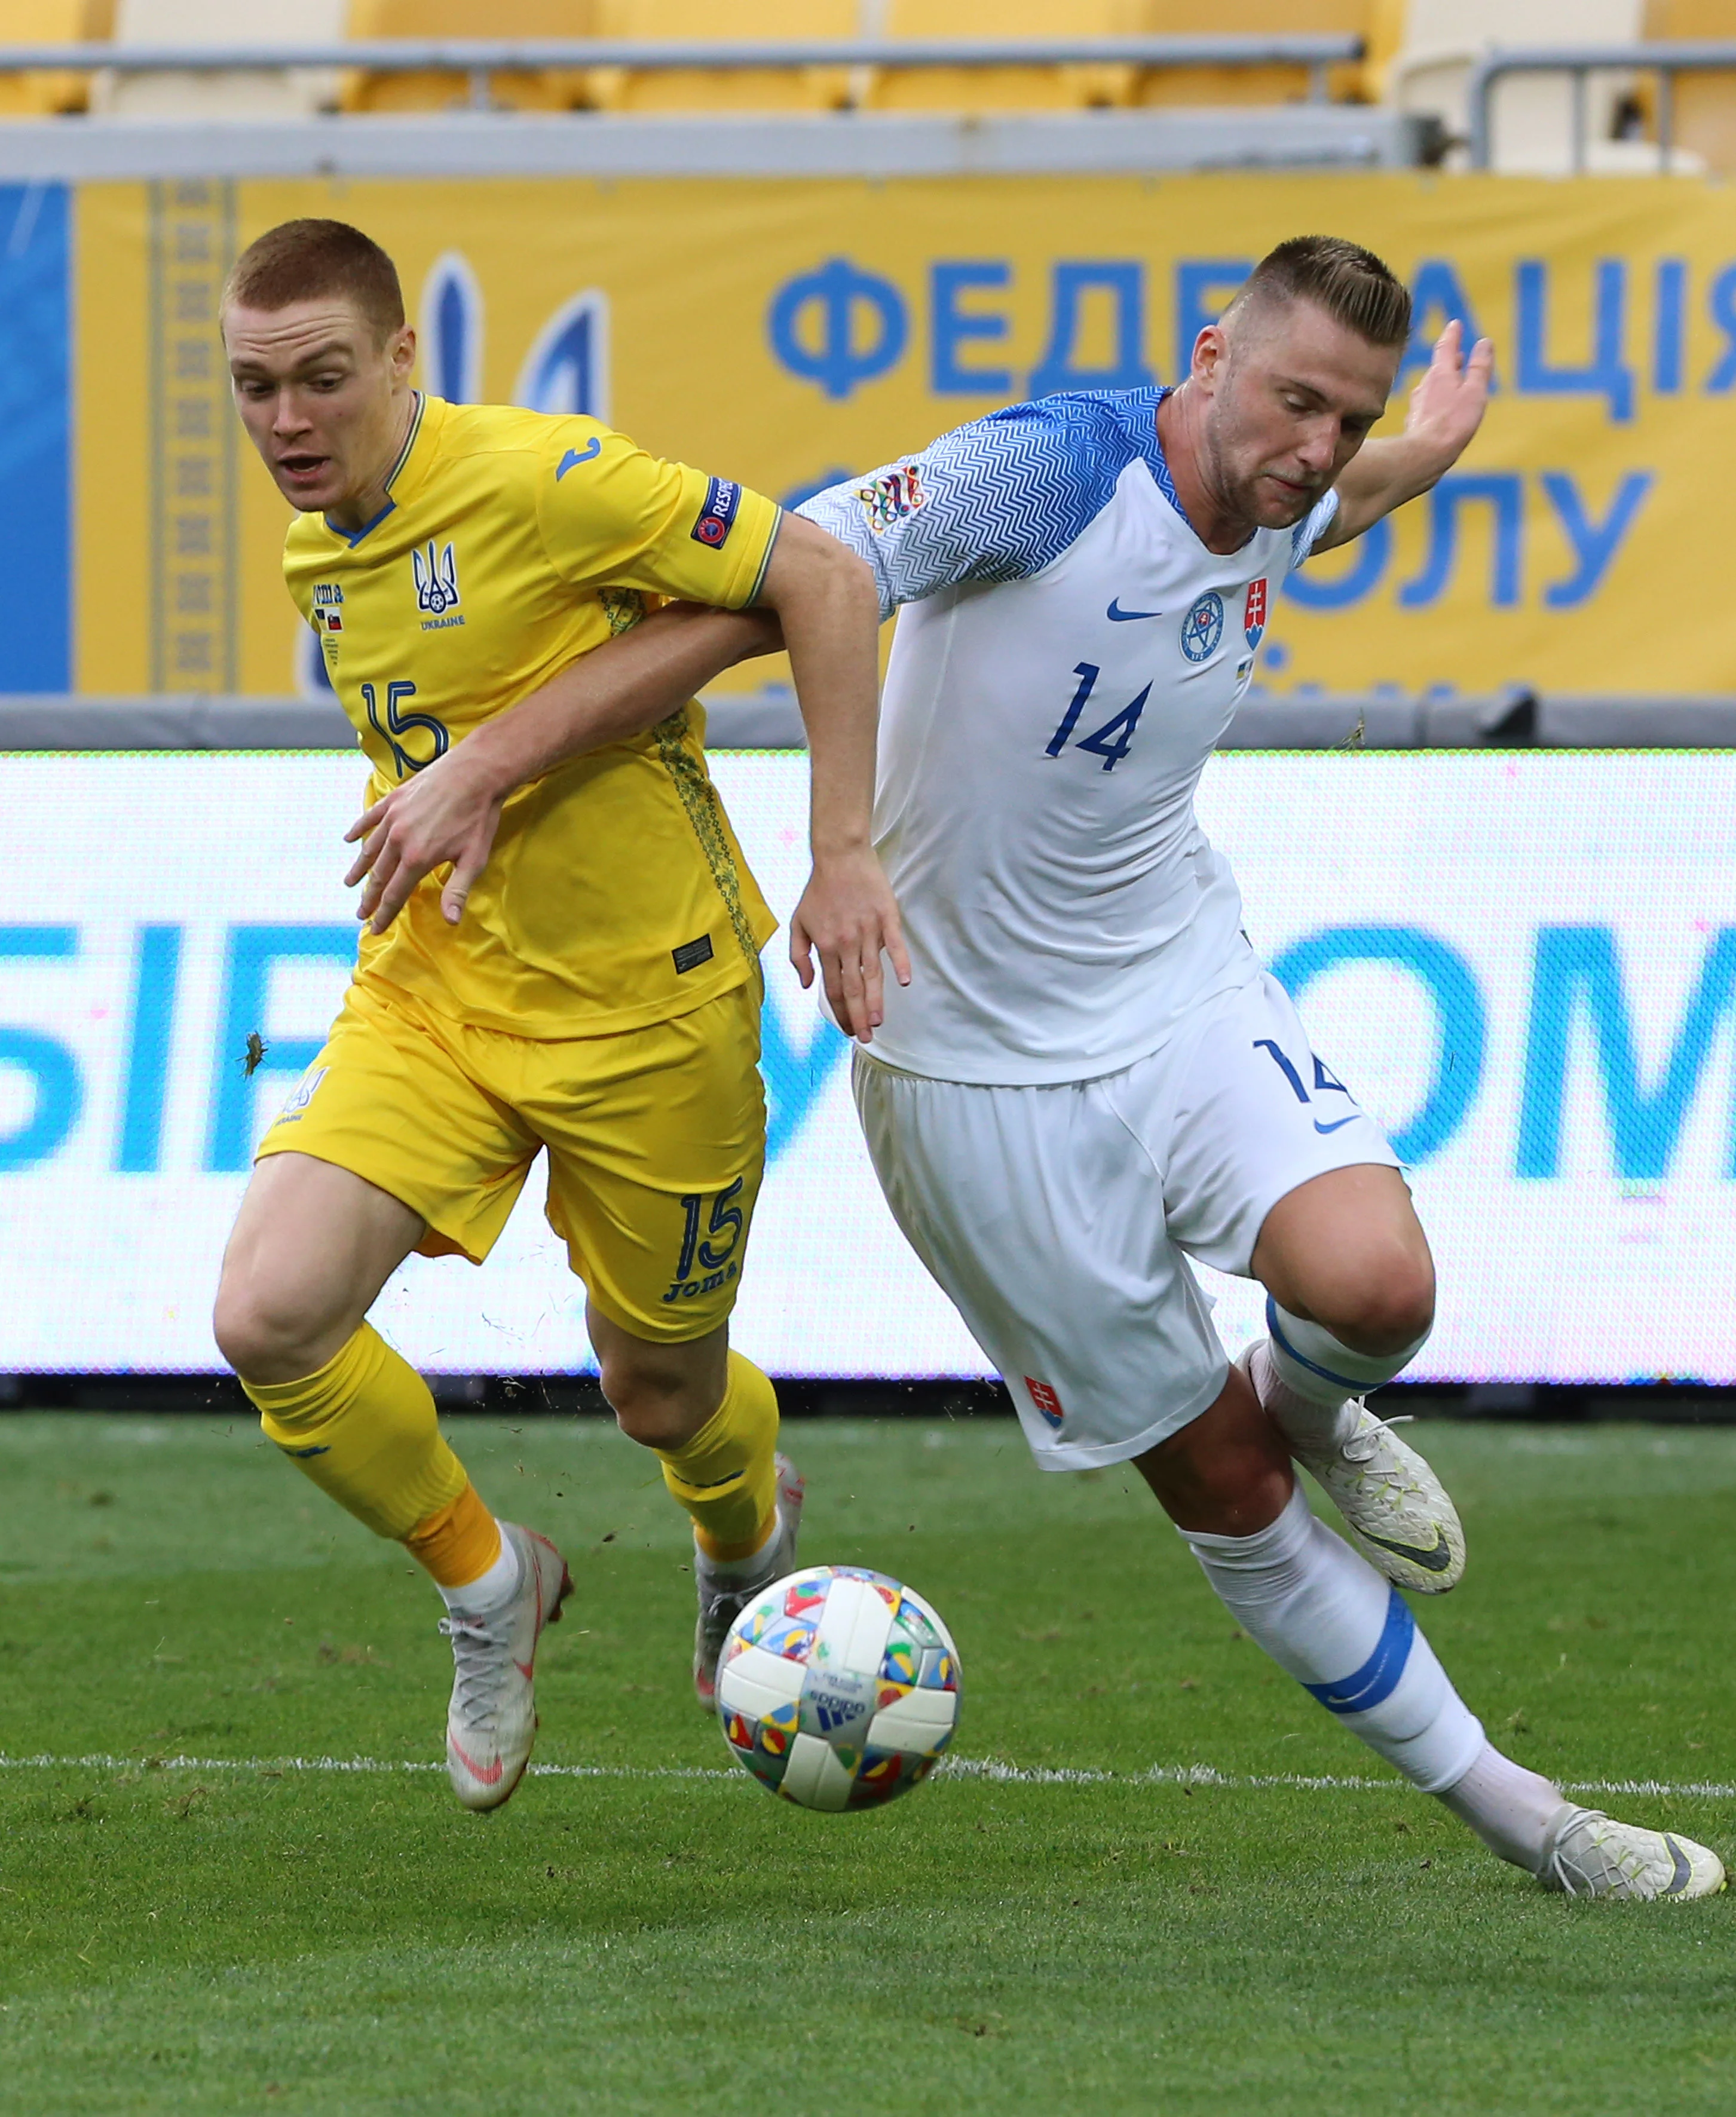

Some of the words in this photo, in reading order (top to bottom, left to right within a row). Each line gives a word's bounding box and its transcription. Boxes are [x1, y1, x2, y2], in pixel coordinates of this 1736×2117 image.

[767, 254, 1736, 425] ФЕДЕАЦІ
[420, 615, 465, 630] UKRAINE
[361, 680, 449, 779] 15
[1045, 661, 1154, 772] 14
[1252, 1038, 1359, 1107] 14
[676, 1175, 743, 1280] 15
